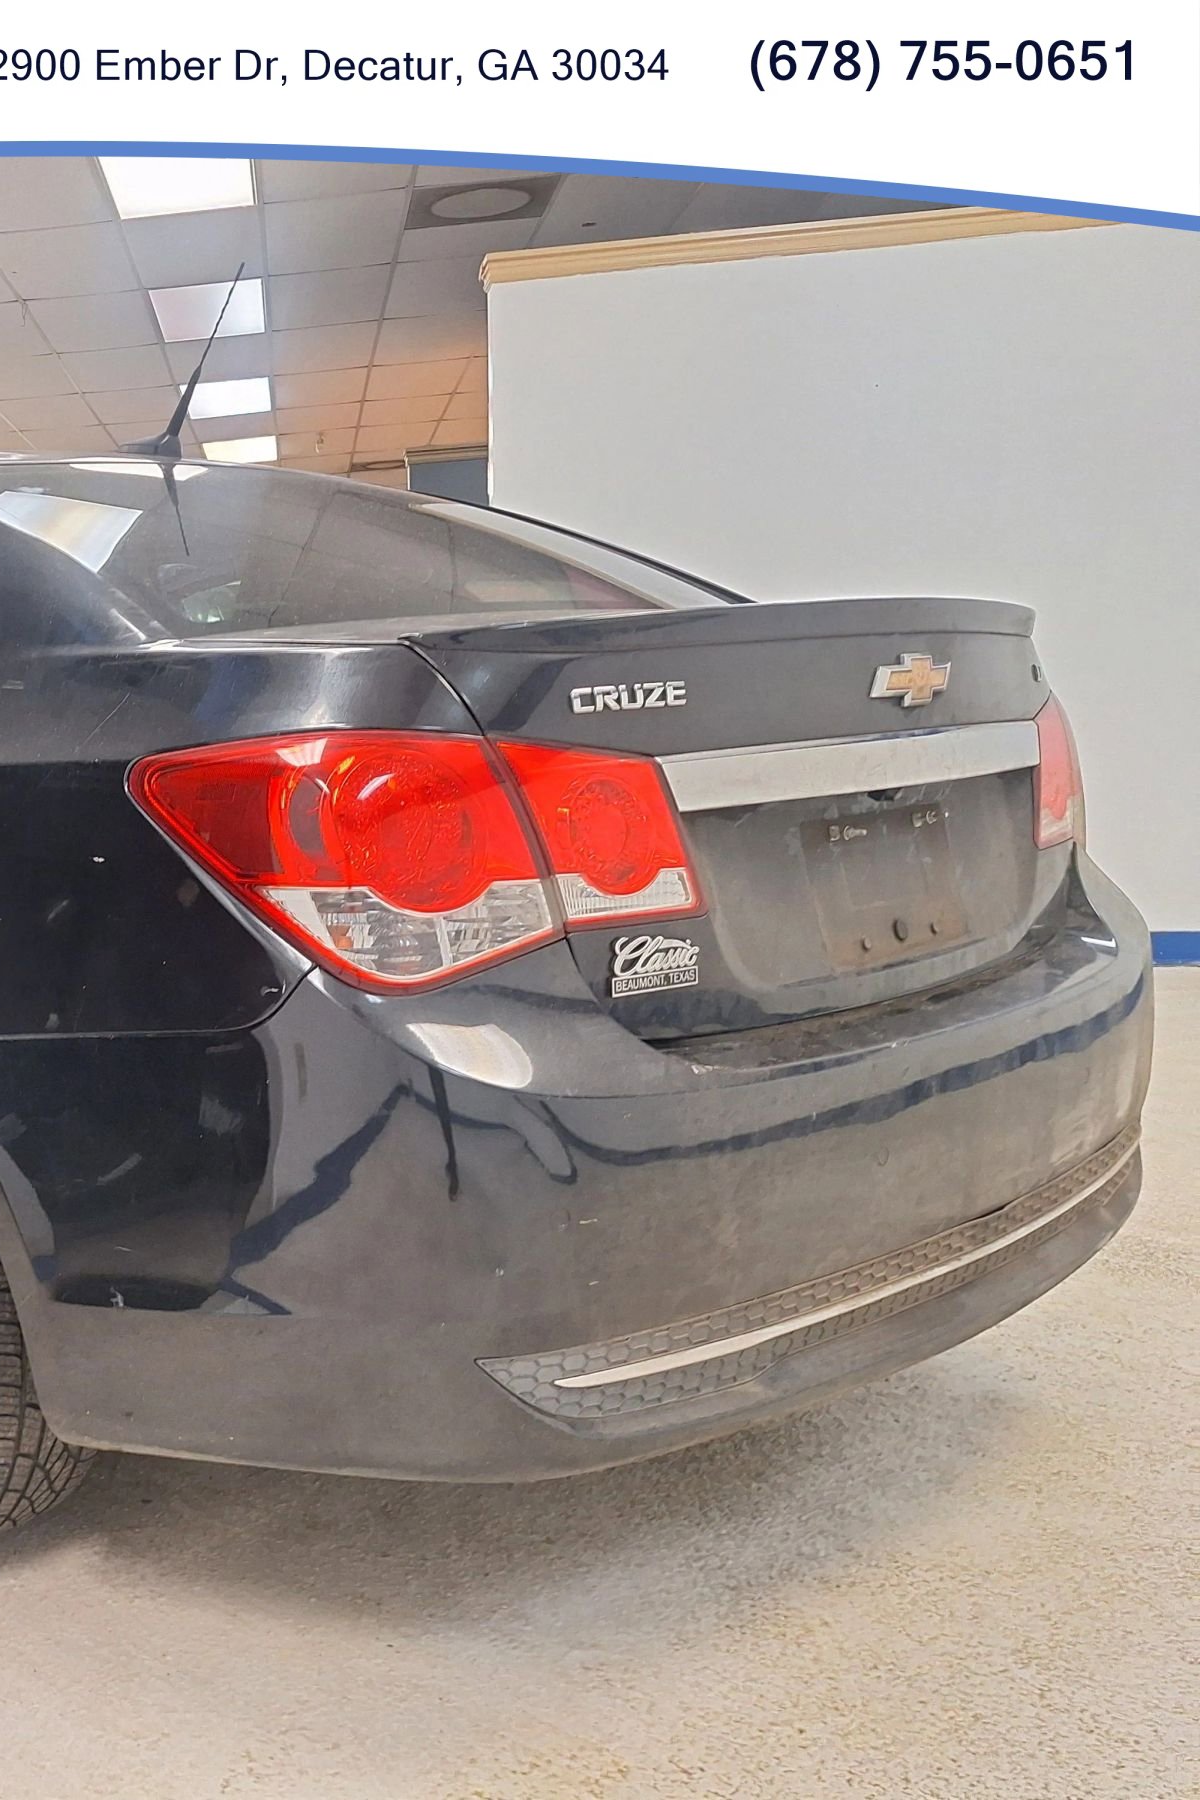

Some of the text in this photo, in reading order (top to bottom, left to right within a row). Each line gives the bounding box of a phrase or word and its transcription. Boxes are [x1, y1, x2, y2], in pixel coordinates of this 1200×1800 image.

[570, 681, 687, 714] CRUZE
[614, 936, 700, 977] Classic
[668, 969, 696, 983] TEXAS
